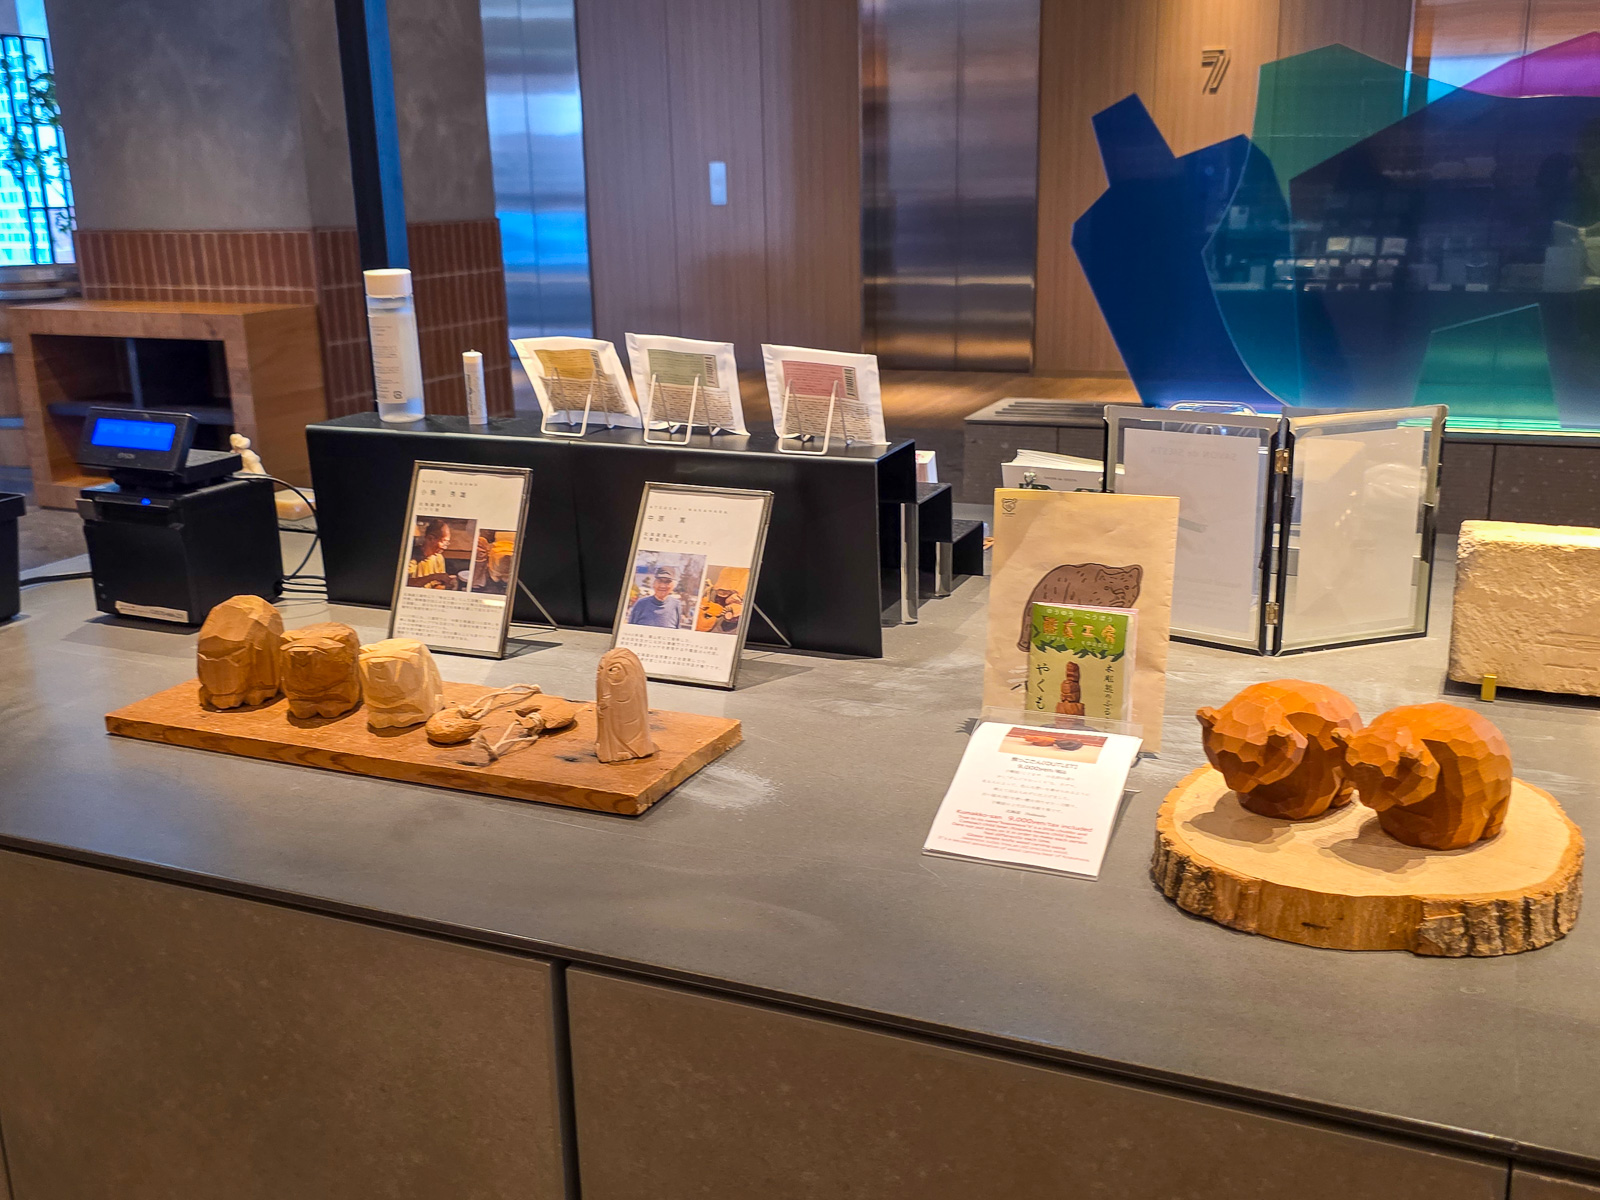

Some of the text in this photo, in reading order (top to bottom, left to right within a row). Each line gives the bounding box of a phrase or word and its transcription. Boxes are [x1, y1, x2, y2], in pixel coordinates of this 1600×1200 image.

[1201, 49, 1231, 95] 7
[1036, 662, 1051, 710] やくも
